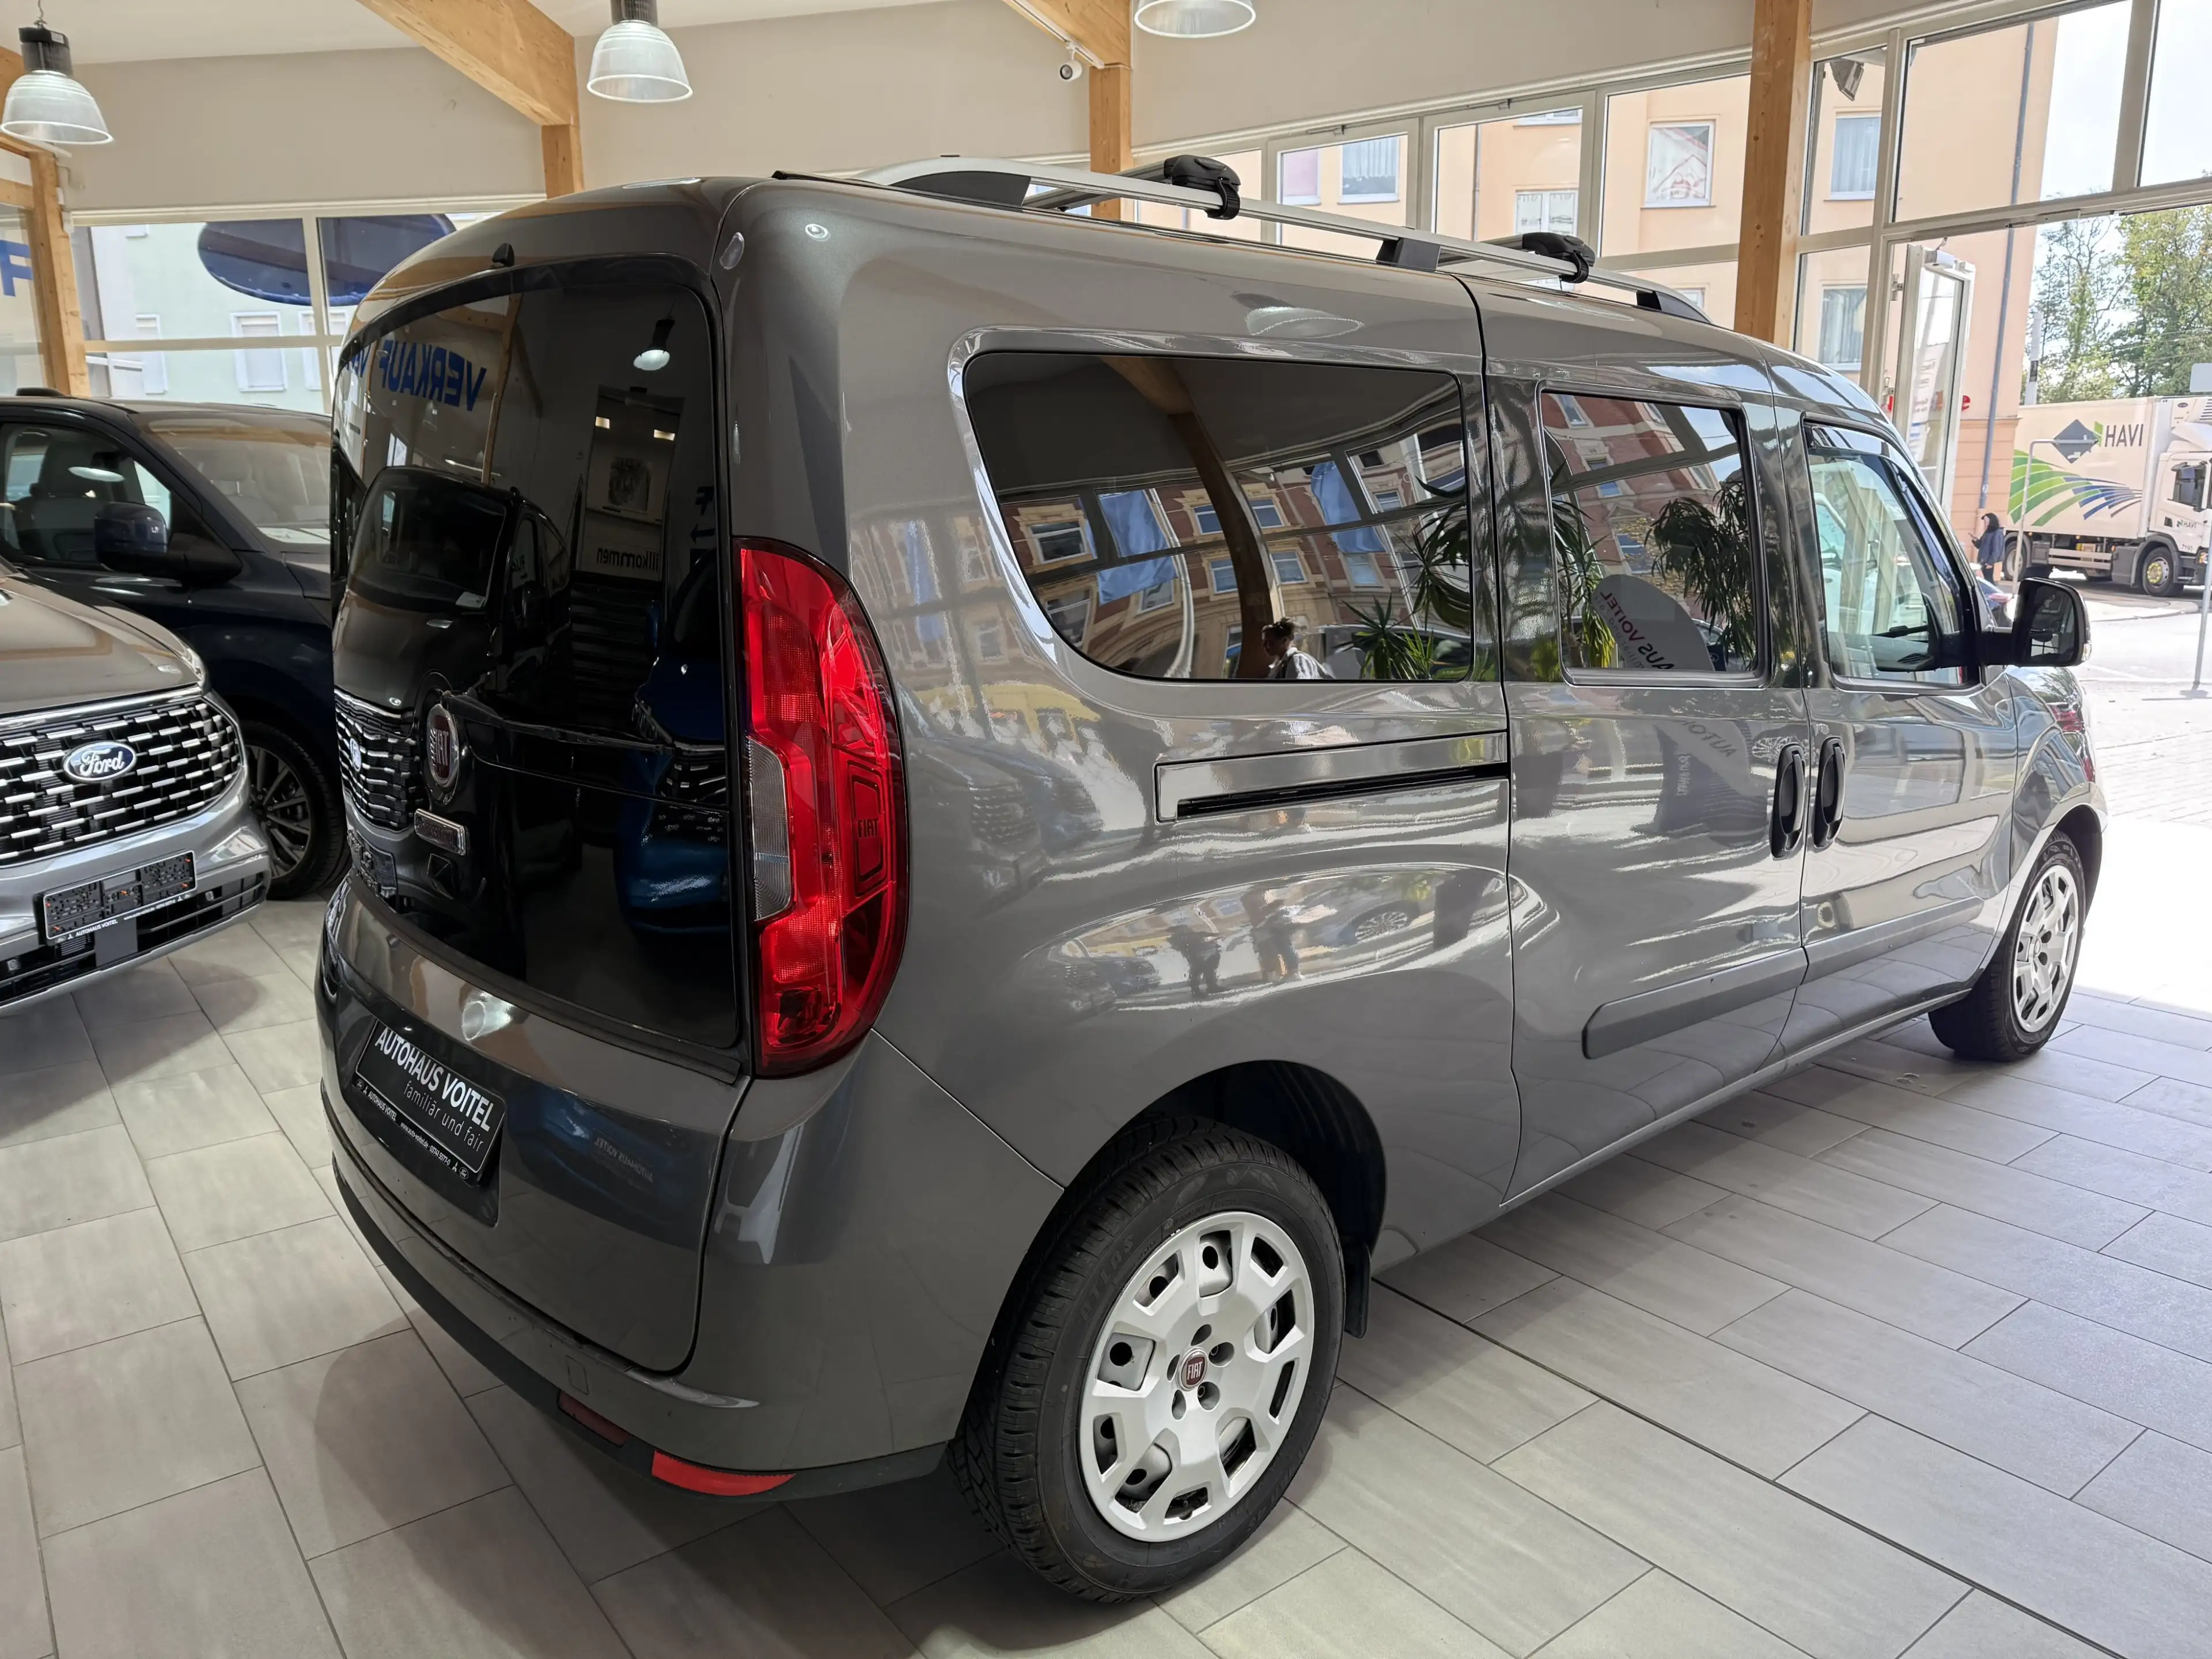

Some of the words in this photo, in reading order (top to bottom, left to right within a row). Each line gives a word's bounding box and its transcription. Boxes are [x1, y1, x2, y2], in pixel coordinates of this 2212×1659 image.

[2104, 423, 2144, 448] HAVI
[2184, 520, 2197, 529] HAVI
[79, 747, 127, 777] Ford
[858, 818, 880, 839] FIAT
[75, 923, 101, 938] AUTOHAUS
[101, 919, 118, 929] VOITEL
[374, 1027, 444, 1092] AUTOHAUS
[441, 1073, 494, 1132] VOITEL
[367, 1091, 386, 1111] AUTOHAUS
[384, 1105, 397, 1122] VOITEL
[403, 1080, 441, 1119] familiär
[441, 1113, 464, 1137] und
[463, 1126, 484, 1152] fair
[399, 1122, 429, 1149] www.auto-voitel.de
[438, 1152, 451, 1166] 5577-0
[1186, 1360, 1203, 1381] FIAT
